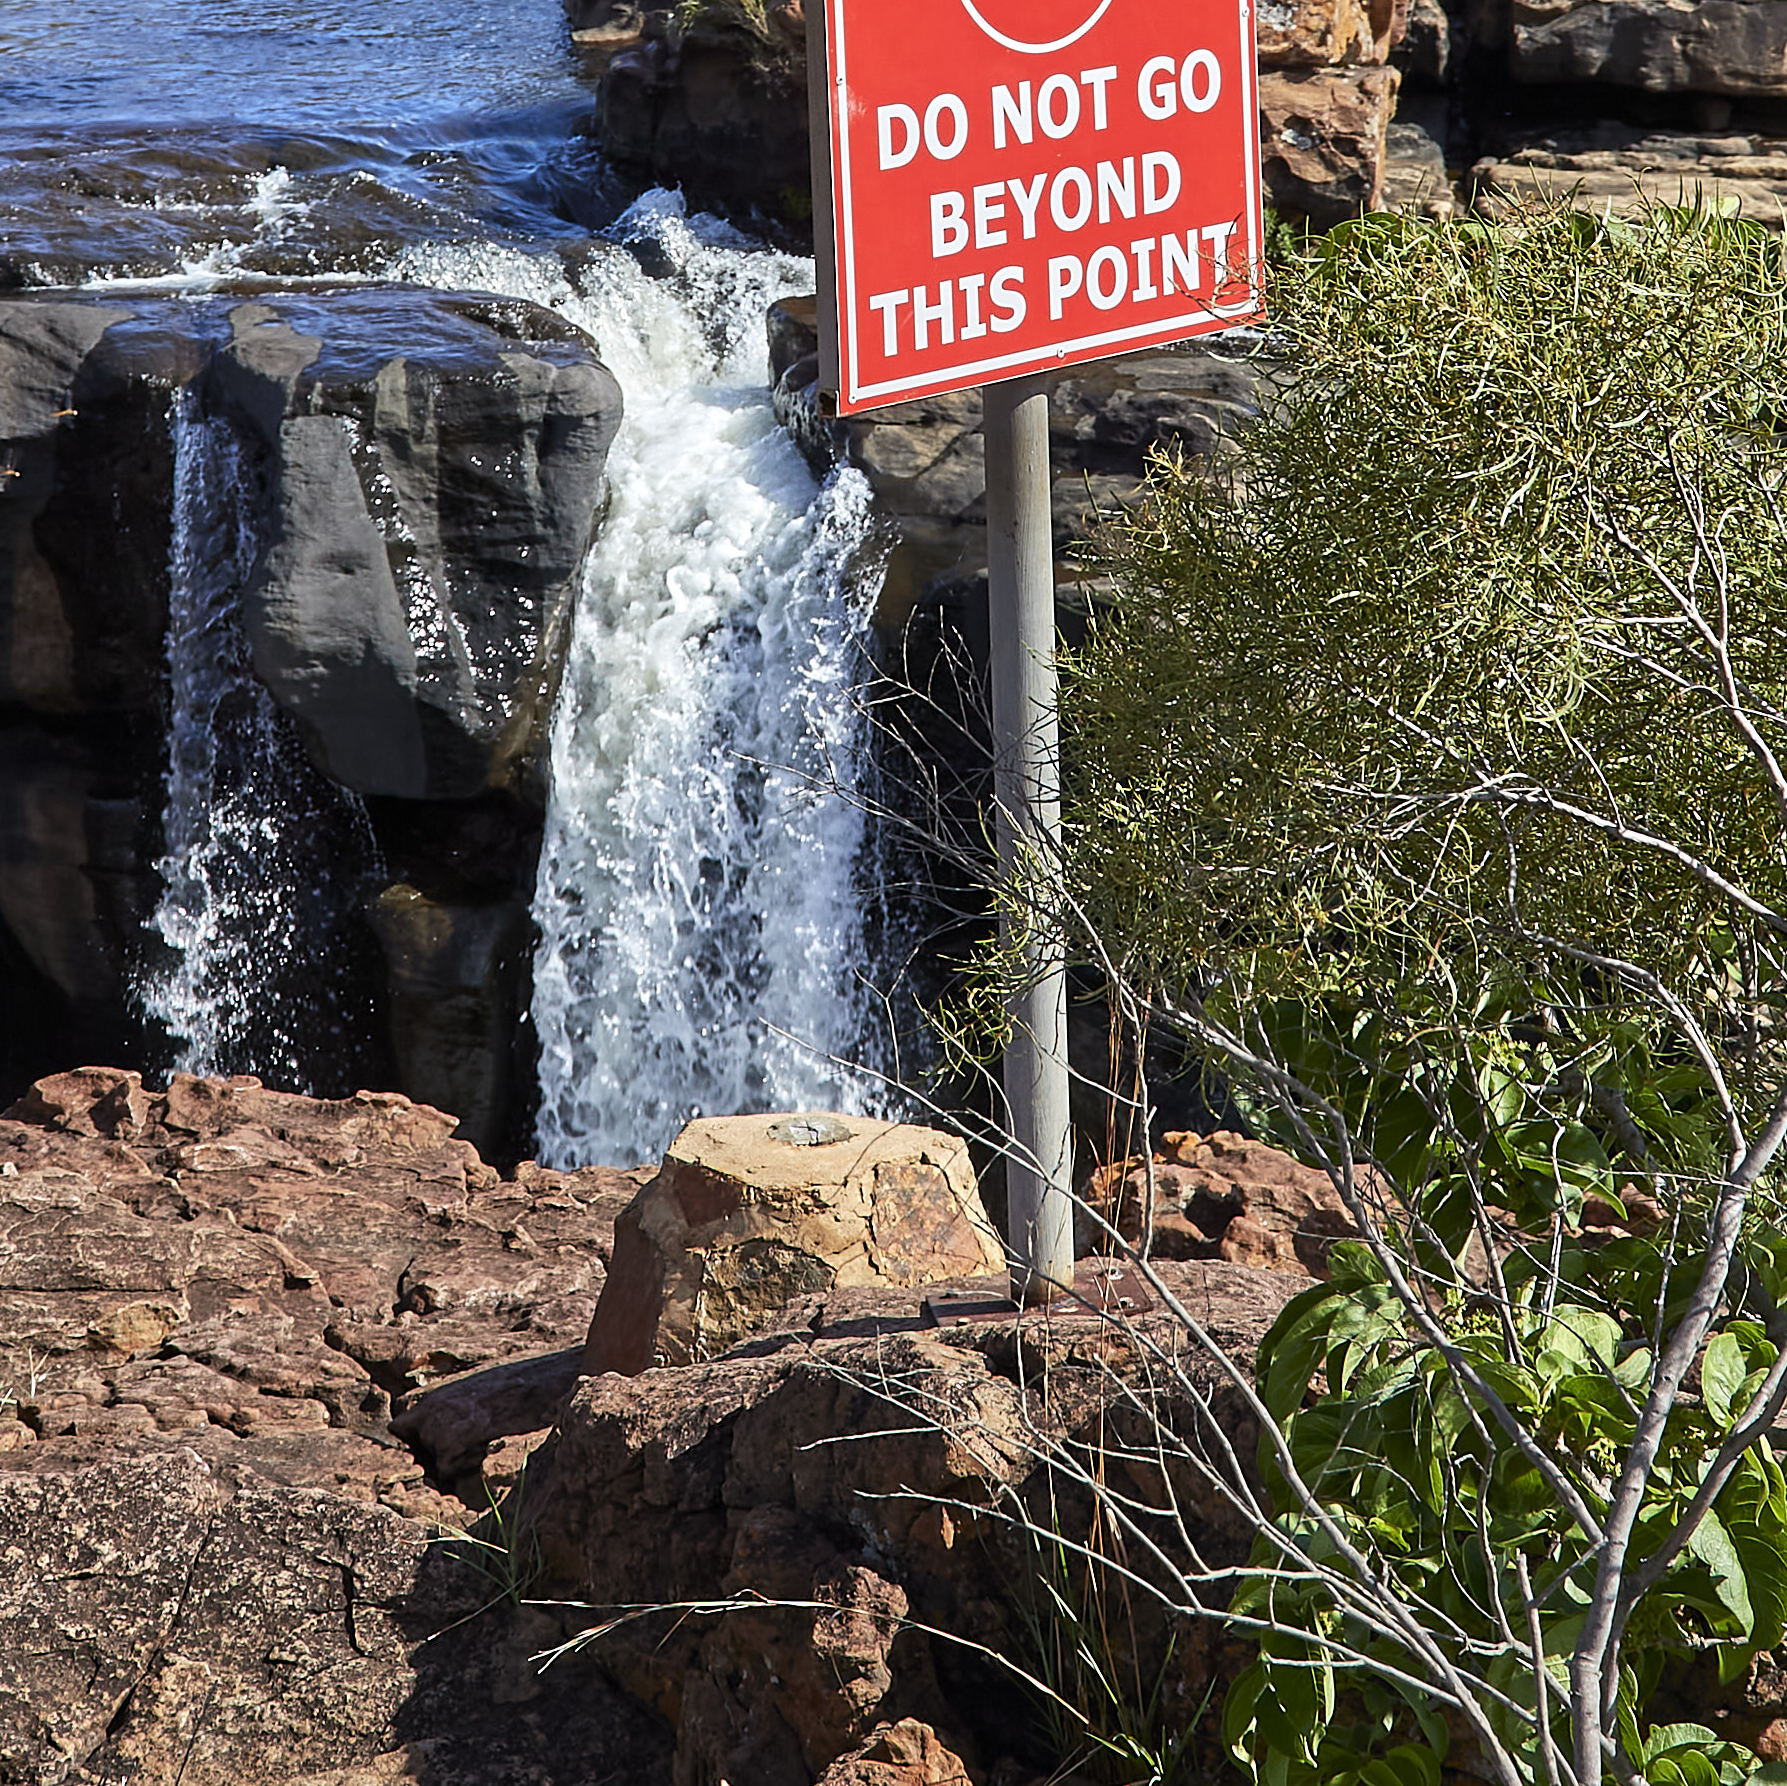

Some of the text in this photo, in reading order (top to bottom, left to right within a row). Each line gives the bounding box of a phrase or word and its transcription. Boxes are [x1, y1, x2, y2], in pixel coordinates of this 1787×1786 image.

[877, 48, 1222, 171] DO NOT GO
[929, 150, 1182, 259] BEYOND
[869, 220, 1237, 357] THIS POINT
